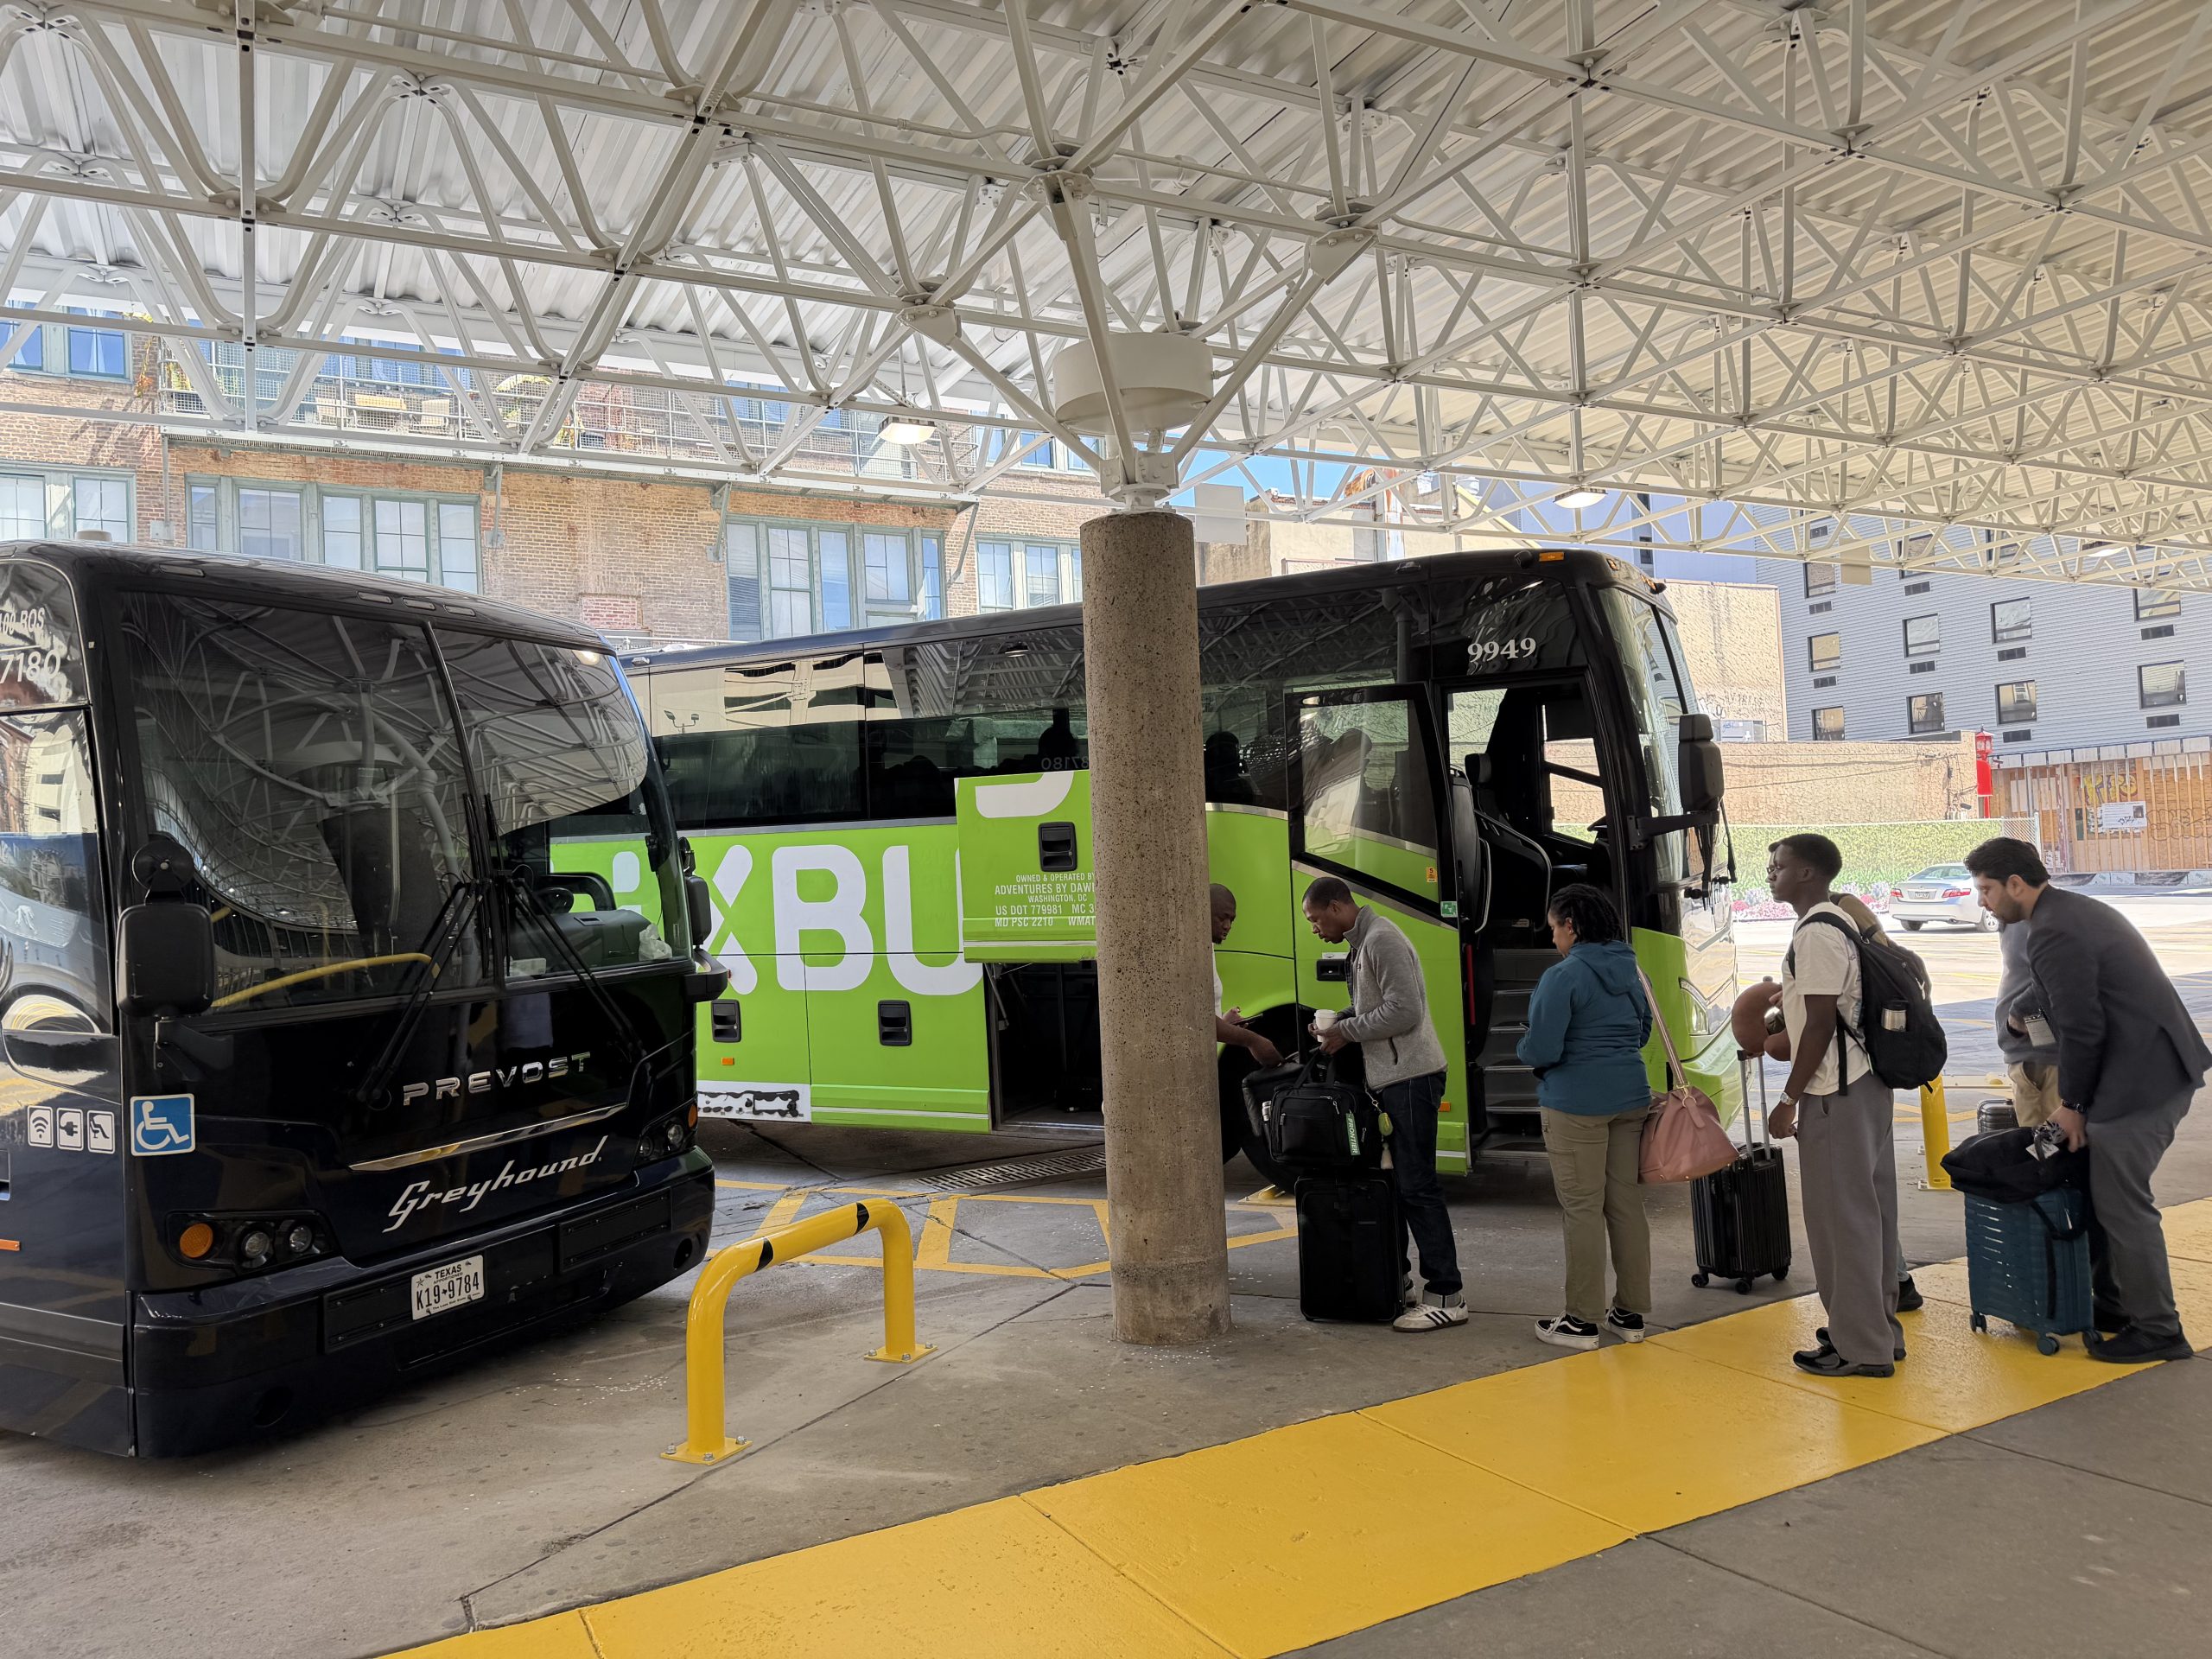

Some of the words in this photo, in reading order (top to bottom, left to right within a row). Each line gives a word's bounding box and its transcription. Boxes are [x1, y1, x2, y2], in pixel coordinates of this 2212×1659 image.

[1468, 637, 1536, 663] 9949
[1015, 874, 1040, 882] OWNED
[1050, 873, 1085, 881] OPERATED
[995, 884, 1052, 895] ADVENTURES
[1056, 883, 1067, 893] BY
[1028, 894, 1076, 903] WASHINGTON,
[995, 906, 1007, 916] US
[1010, 905, 1028, 915] DOT
[1031, 904, 1062, 914] 779981
[1071, 904, 1086, 914] MC
[995, 917, 1009, 927] MD
[1011, 917, 1029, 926] PSC
[1032, 917, 1053, 926] 2210
[403, 1051, 591, 1107] PREVOST
[1347, 1117, 1358, 1154] FRONTIER
[434, 1263, 462, 1280] TEXAS
